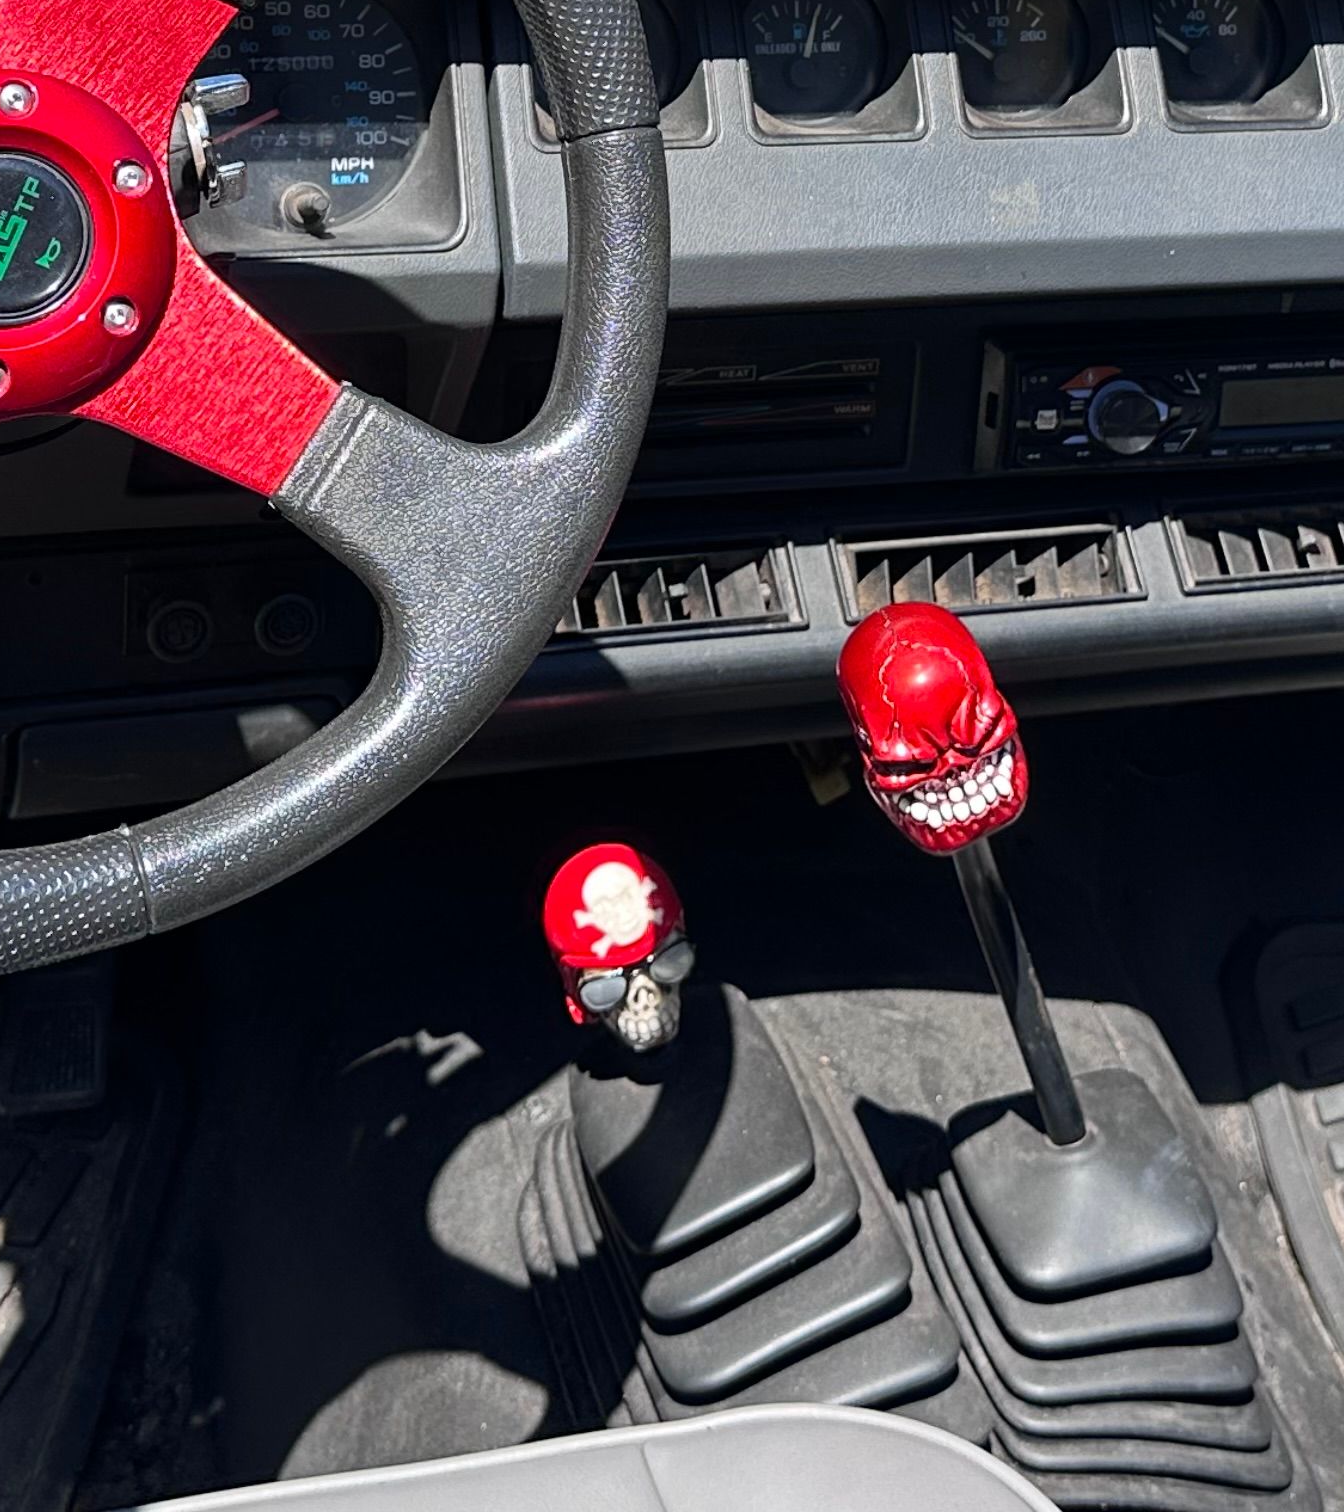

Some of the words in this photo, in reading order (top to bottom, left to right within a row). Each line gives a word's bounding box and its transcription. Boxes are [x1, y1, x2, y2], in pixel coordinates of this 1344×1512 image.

[264, 1, 292, 16] 50
[303, 4, 331, 19] 60
[1186, 10, 1206, 21] 40
[339, 24, 365, 38] 70
[358, 53, 386, 69] 80
[368, 90, 396, 105] 90
[355, 130, 388, 145] 100
[330, 156, 375, 171] MPH
[330, 172, 370, 185] km/h
